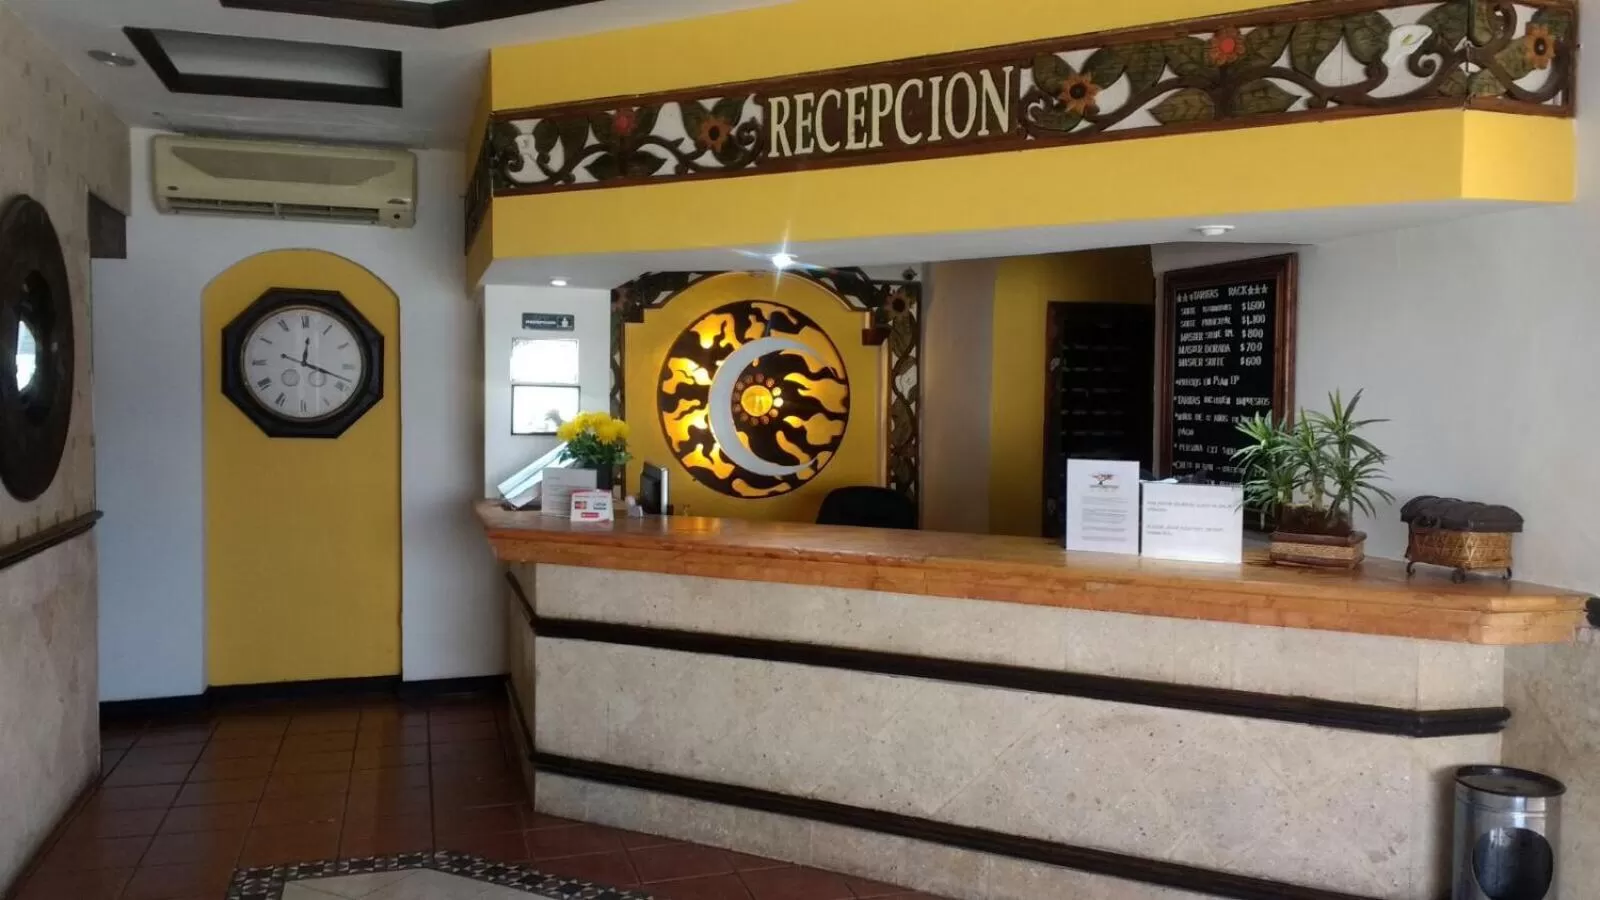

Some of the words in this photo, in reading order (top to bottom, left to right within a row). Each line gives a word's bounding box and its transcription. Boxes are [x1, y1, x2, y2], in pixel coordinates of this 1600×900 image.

[767, 66, 1014, 158] RECEPCION
[1228, 285, 1247, 297] RACK
[1178, 345, 1203, 354] MASTER
